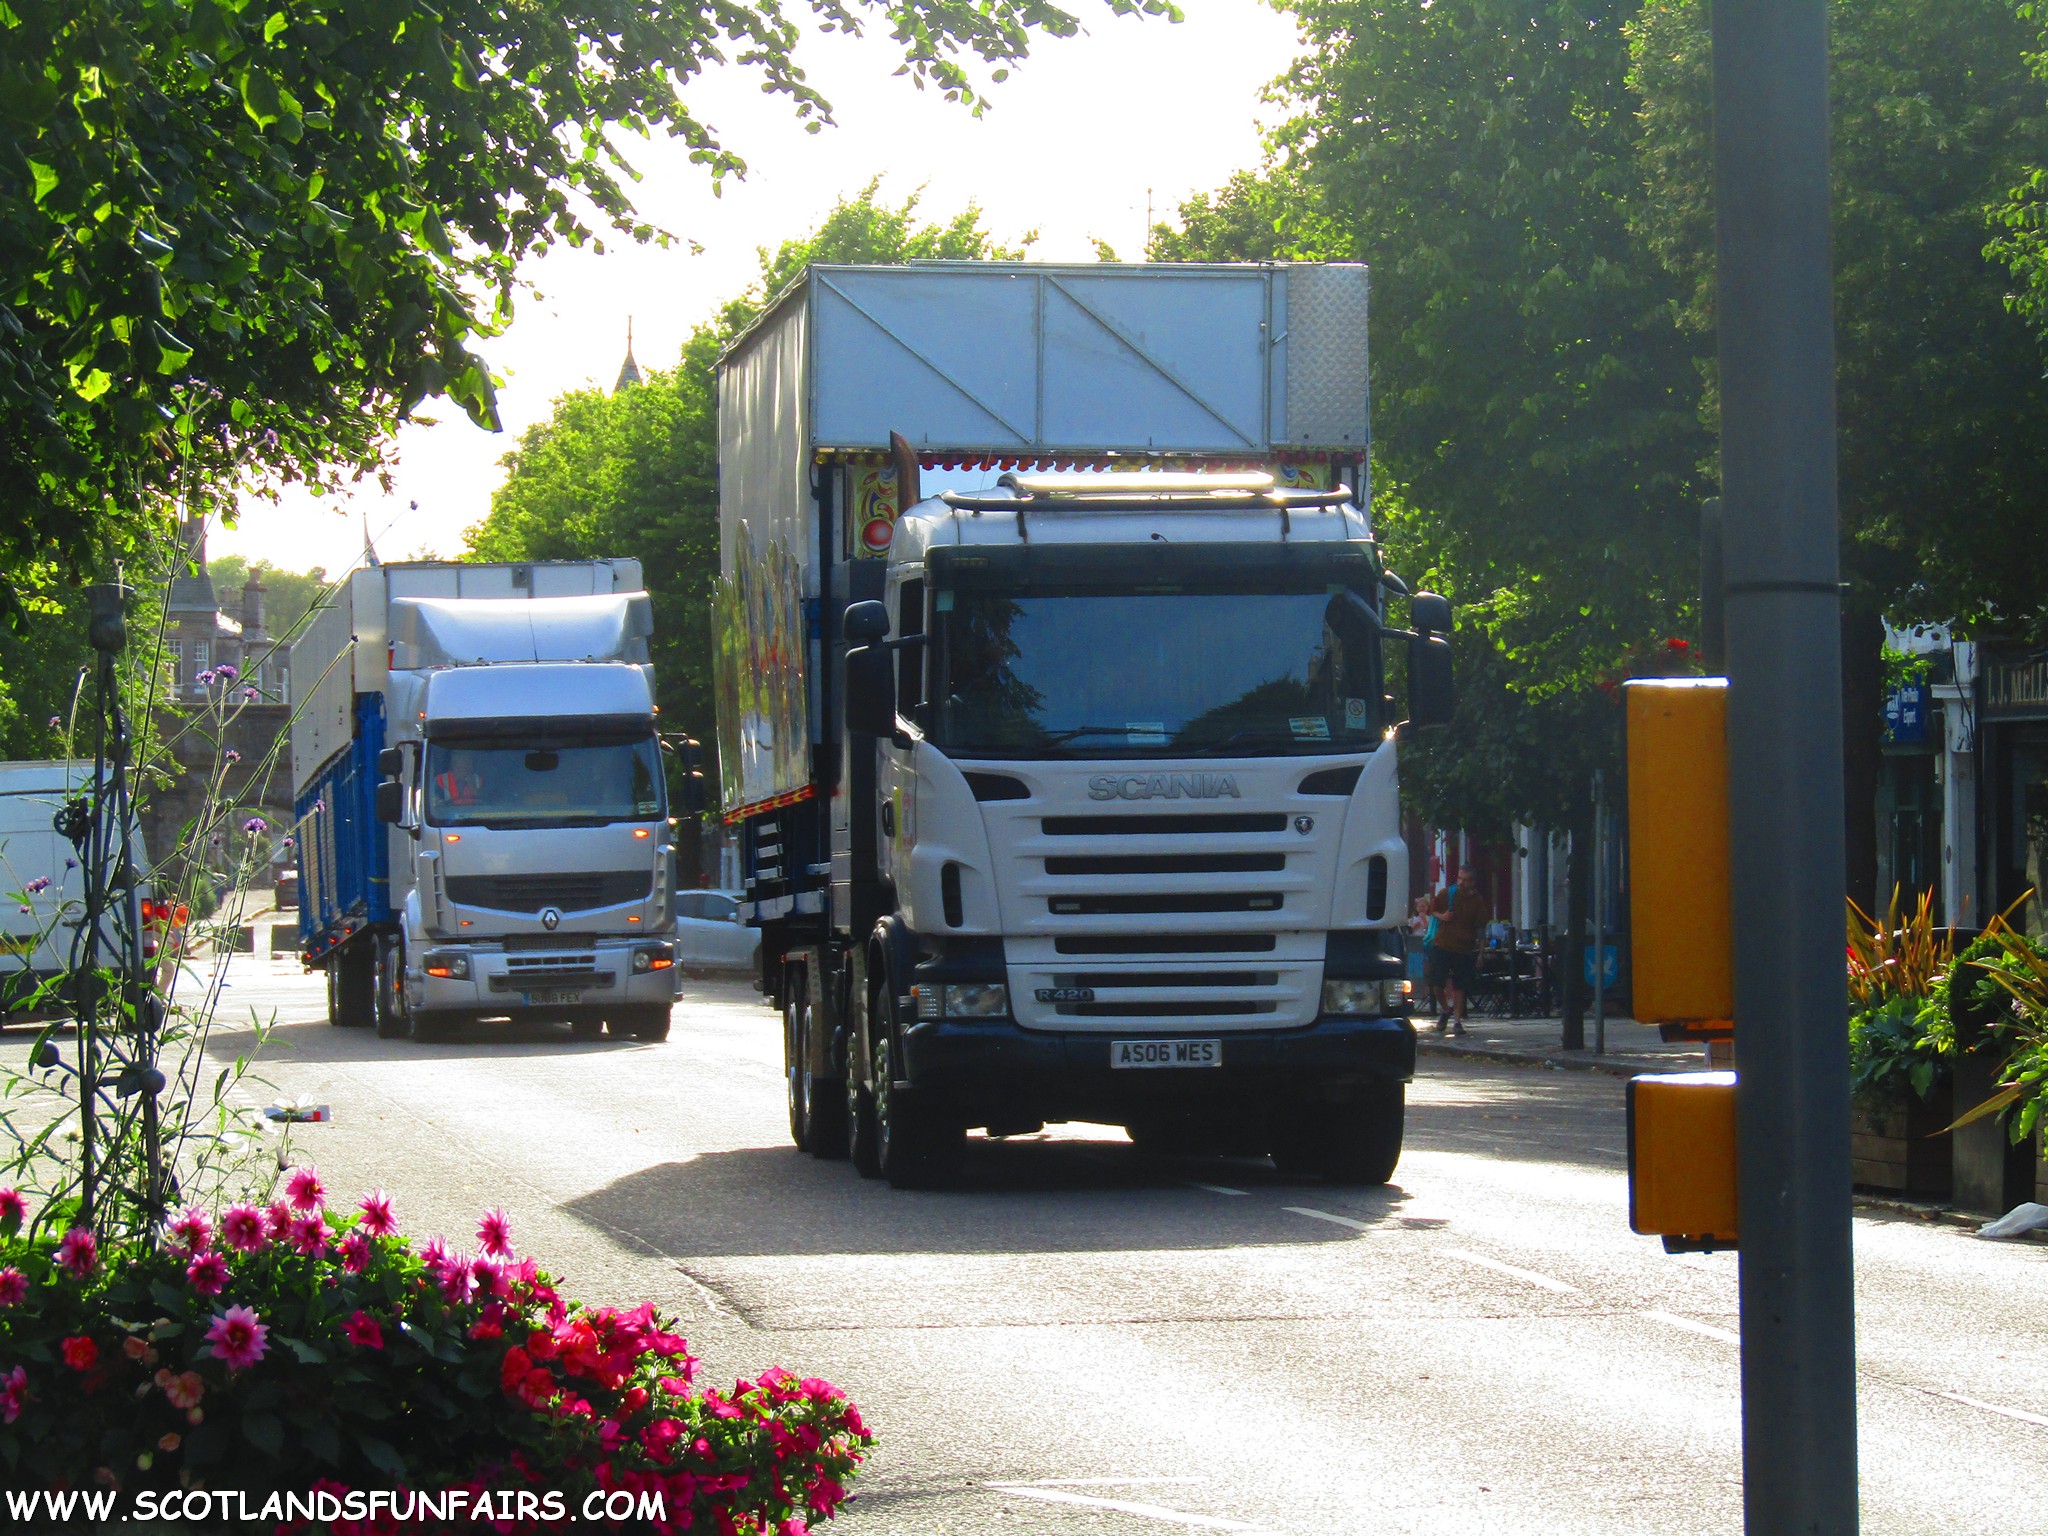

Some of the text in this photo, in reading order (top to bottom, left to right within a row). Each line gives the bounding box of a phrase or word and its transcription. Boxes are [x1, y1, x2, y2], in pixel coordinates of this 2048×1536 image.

[1088, 773, 1241, 801] SCANIA
[1053, 989, 1093, 1000] 420
[1120, 1043, 1214, 1063] AS06 WES
